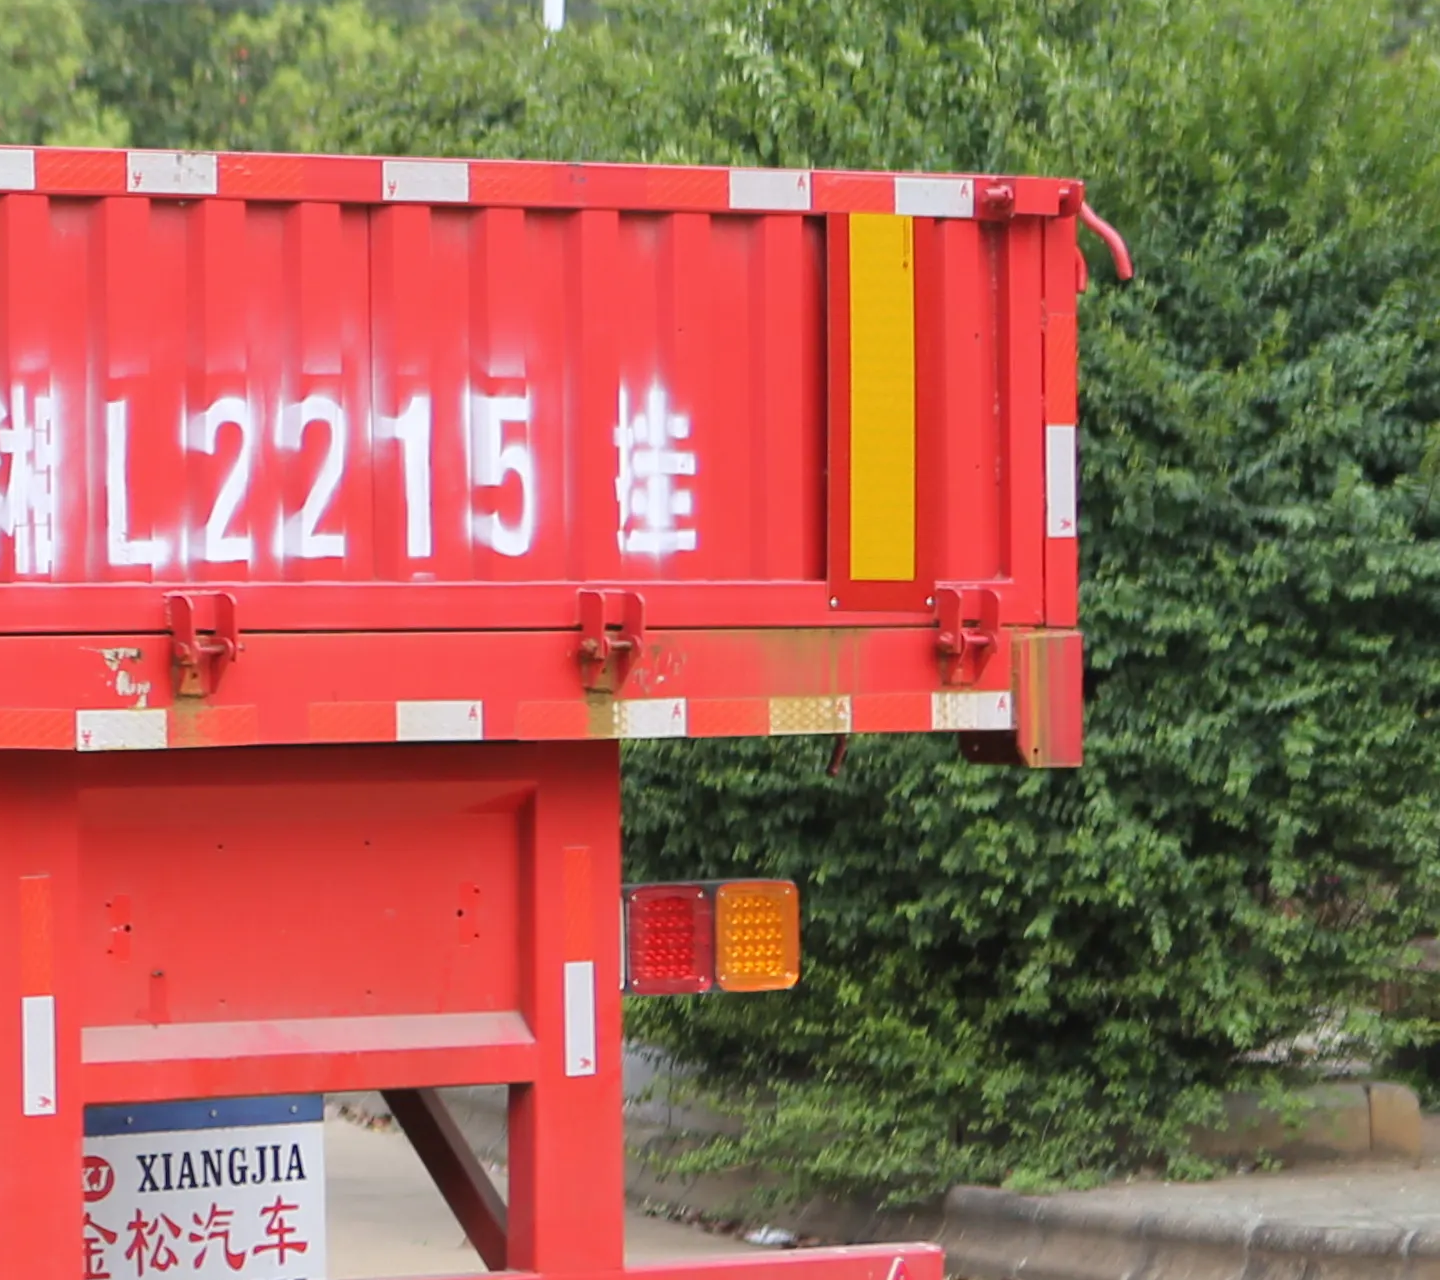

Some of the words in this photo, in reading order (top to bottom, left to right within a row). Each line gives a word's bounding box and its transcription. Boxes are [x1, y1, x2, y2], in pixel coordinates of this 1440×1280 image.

[136, 1143, 307, 1193] XIANGJIA
[83, 1195, 309, 1280] 金松汽车
